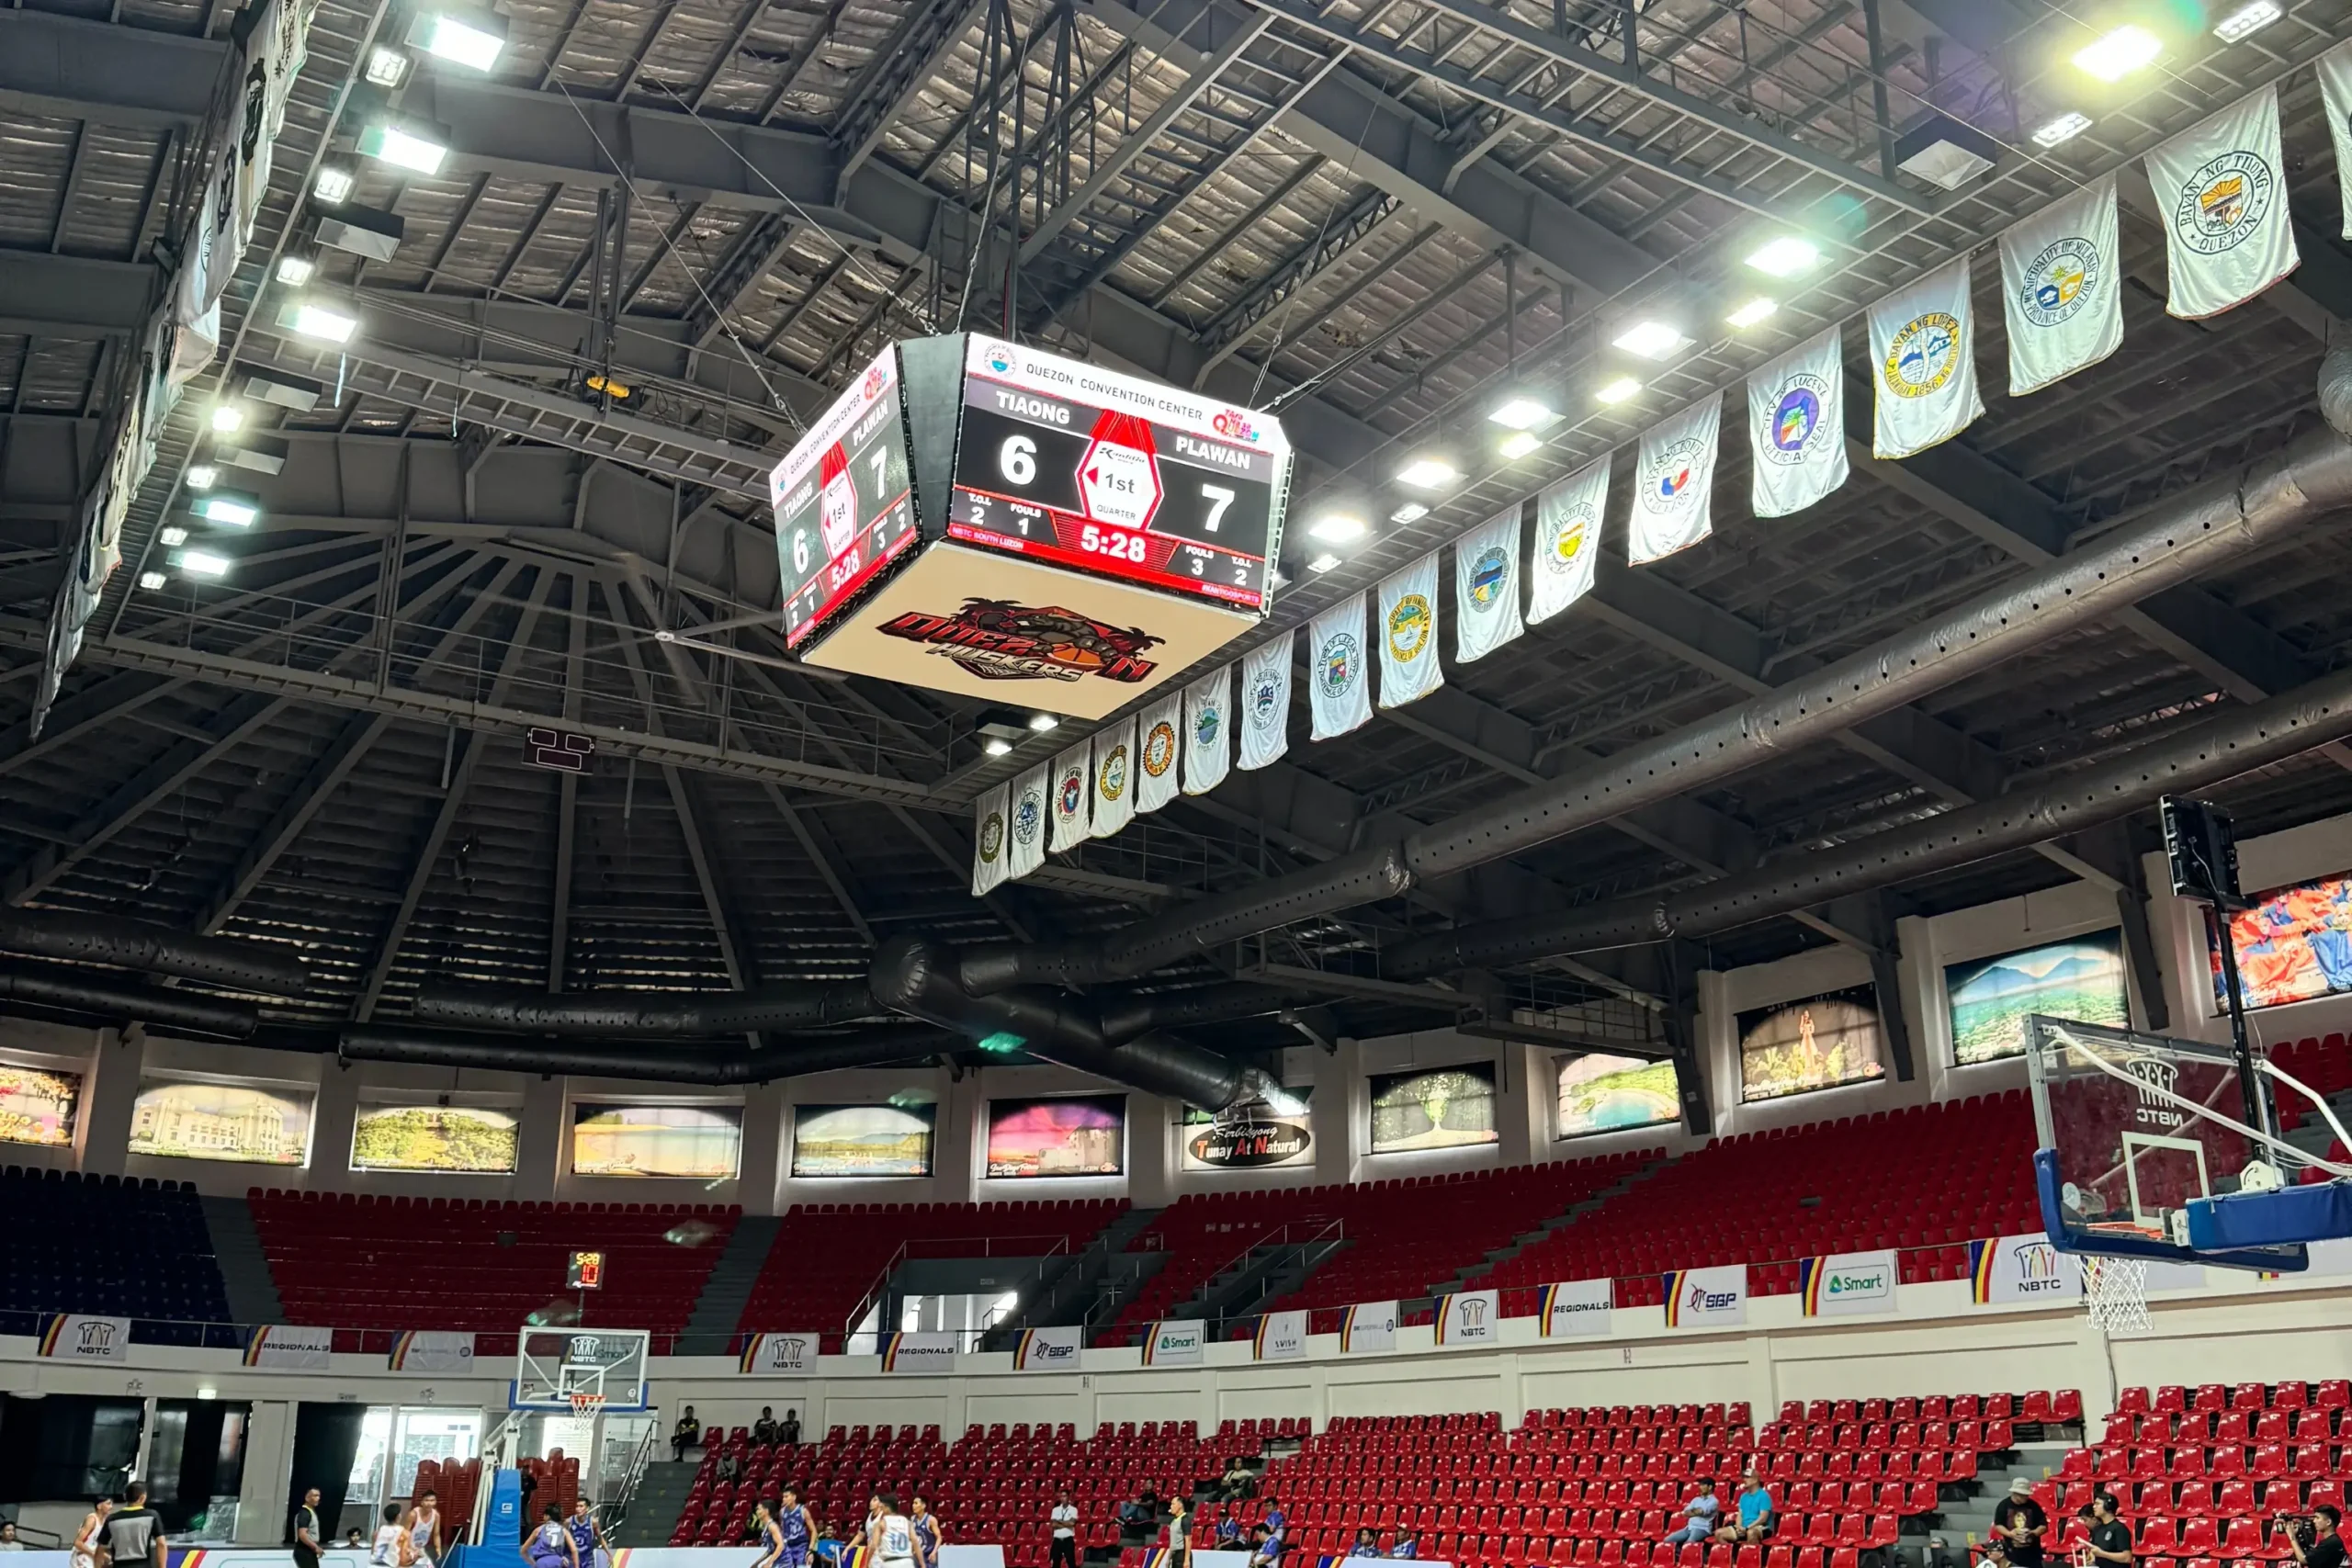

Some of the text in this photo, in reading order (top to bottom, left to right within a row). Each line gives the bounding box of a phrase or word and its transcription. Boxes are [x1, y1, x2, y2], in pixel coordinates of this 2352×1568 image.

[2180, 182, 2200, 227] BAYAN
[2205, 160, 2223, 178] NG
[2199, 215, 2257, 251] QUEZON
[2024, 246, 2058, 303] MUNICIPALITY
[2062, 241, 2074, 253] OF
[2027, 280, 2094, 324] PROVINCE OF QUEZON
[1917, 317, 1928, 329] NG
[1933, 314, 1958, 332] LOPEZ
[1026, 364, 1203, 420] QUEZON CONVENTION CENTER
[1915, 379, 1938, 395] 1856
[996, 390, 1070, 424] TIAONG
[1764, 402, 1776, 429] CITY
[1794, 377, 1826, 396] LUCENA
[853, 400, 888, 446] PLAWAN
[790, 394, 860, 474] QUEZON CONVENTION CENTER
[1001, 435, 1036, 485] 6
[1176, 435, 1250, 469] PLAWAN
[871, 445, 887, 500] 7
[1105, 473, 1135, 493] 1st
[784, 481, 813, 518] TIAONG
[1202, 483, 1236, 532] 7
[832, 502, 846, 523] 1st
[969, 506, 985, 525] 2
[1010, 502, 1041, 518] FOULS
[1097, 504, 1136, 520] QUARTER
[898, 513, 906, 532] 2
[1018, 518, 1029, 535] 1
[878, 532, 886, 549] 3
[952, 526, 1023, 549] NBTC SOUTH LUZON
[1080, 525, 1146, 563] 5:28
[793, 528, 808, 573] 6
[1185, 545, 1214, 559] FOULS
[831, 548, 860, 591] 5:28
[1191, 558, 1204, 575] 3
[1234, 569, 1247, 586] 2
[808, 596, 814, 611] 1
[792, 611, 798, 626] 2
[925, 643, 1085, 682] HUSKERS
[1197, 1136, 1300, 1160] Tunay At Natural
[576, 1253, 600, 1265] 5:28
[582, 1264, 598, 1283] 10
[1844, 1273, 1883, 1291] Smart
[2018, 1279, 2061, 1292] NBTC
[1554, 1301, 1610, 1314] REGIONALS
[1706, 1292, 1736, 1308] SBP
[1461, 1327, 1486, 1337] NBTC
[76, 1346, 110, 1355] NBTC
[264, 1342, 329, 1352] REGIONALS
[1048, 1346, 1073, 1357] SBP
[1170, 1336, 1195, 1348] Smart
